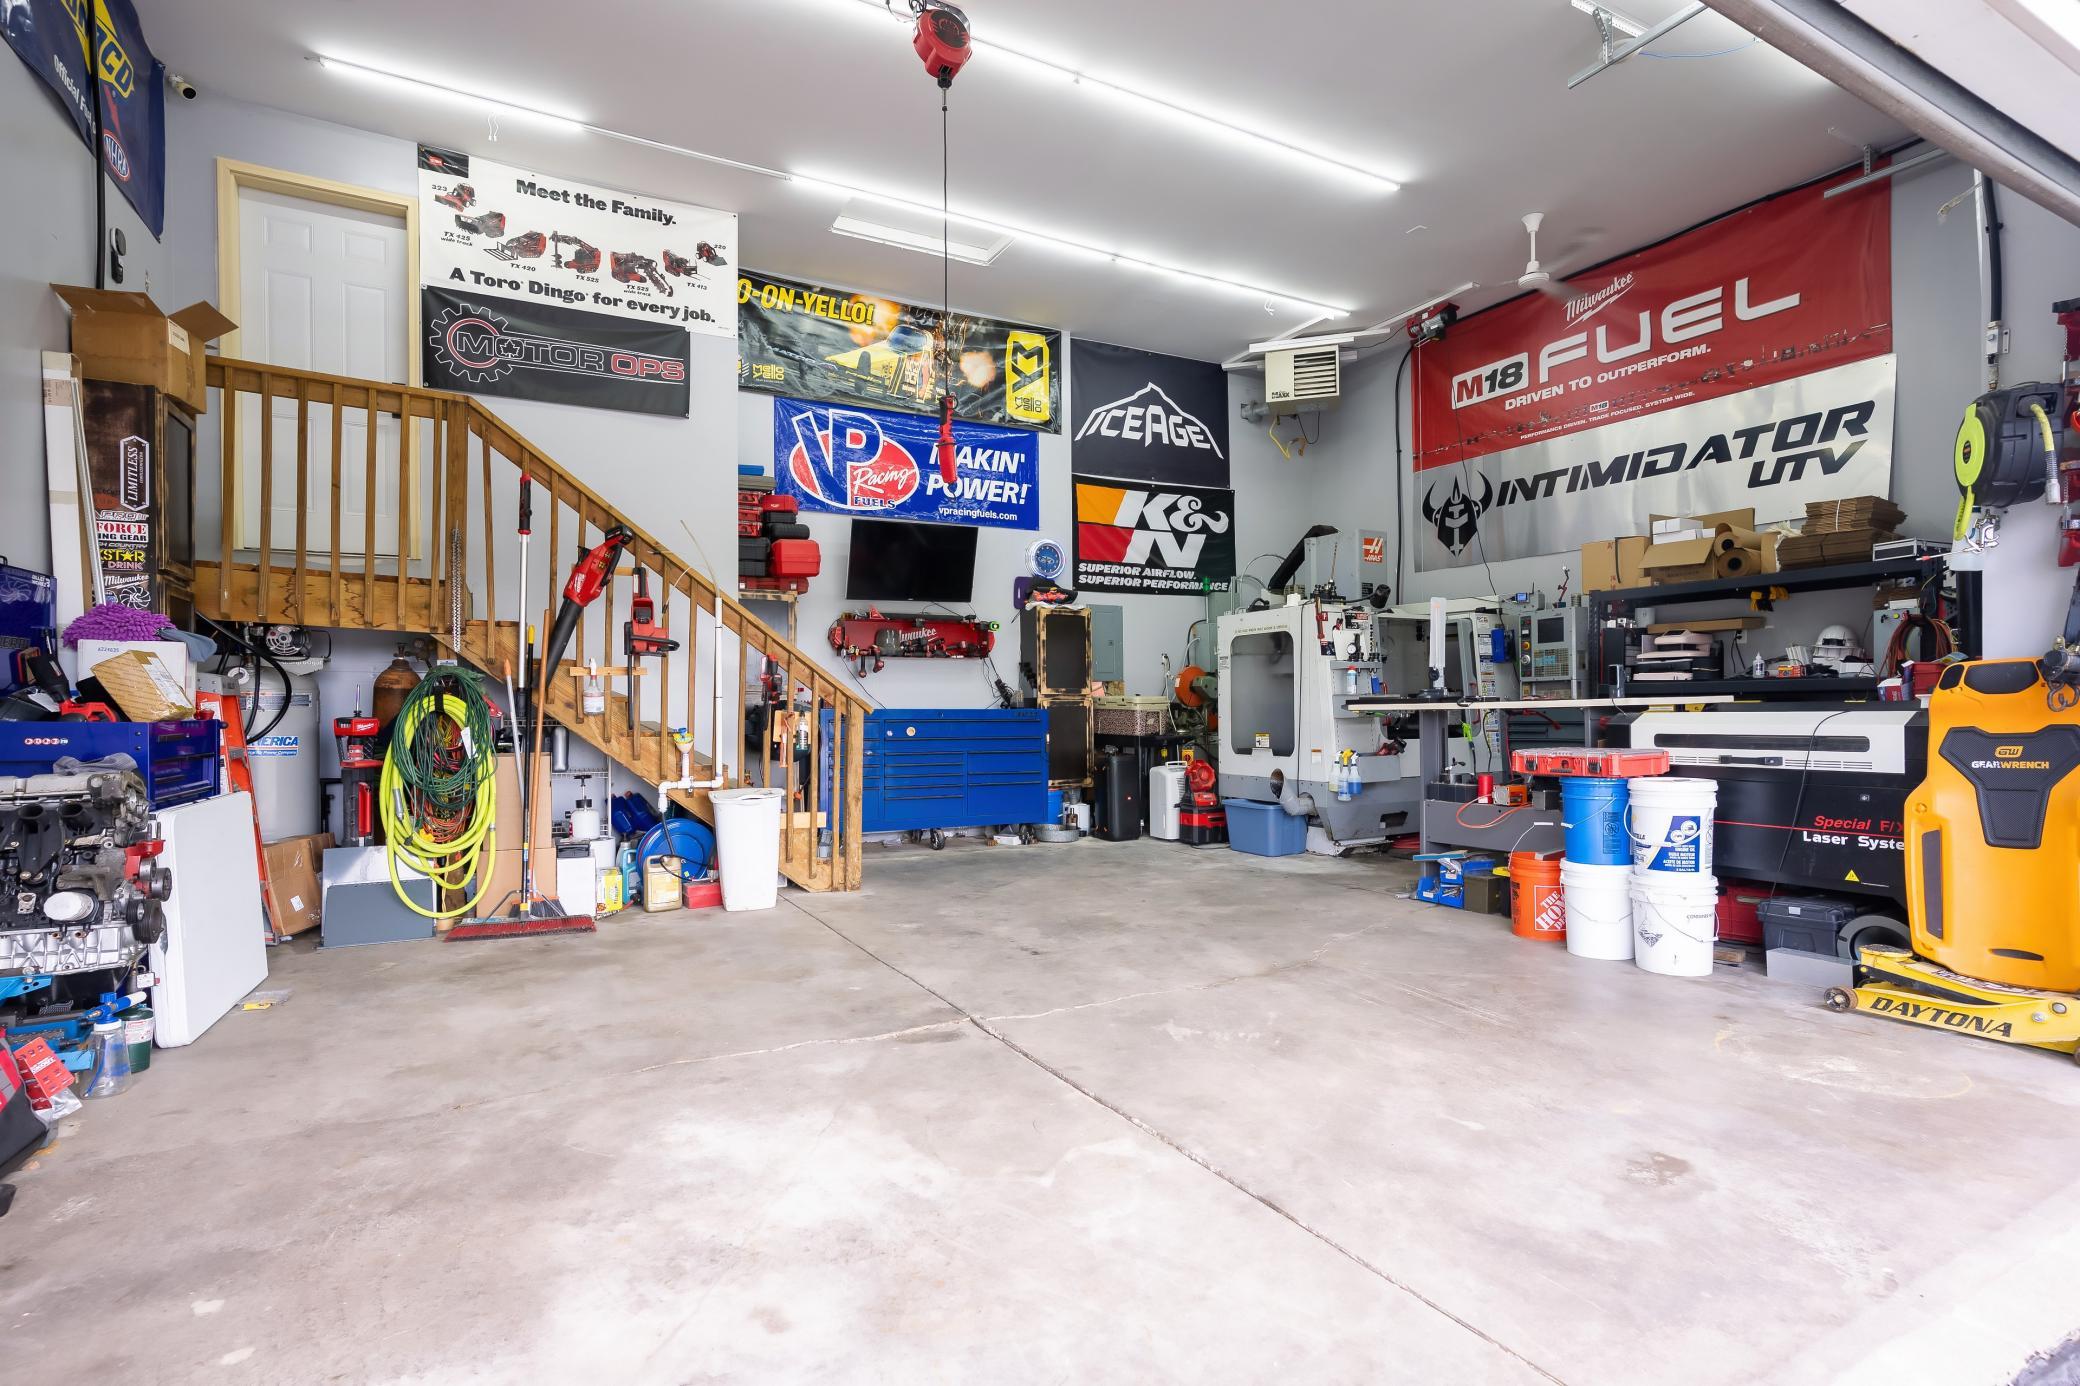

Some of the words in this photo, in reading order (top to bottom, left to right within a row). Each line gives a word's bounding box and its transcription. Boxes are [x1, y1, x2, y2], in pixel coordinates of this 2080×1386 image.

[53, 55, 78, 104] Official
[104, 135, 127, 175] NHRA
[516, 179, 570, 203] Meet
[574, 192, 607, 211] the
[611, 200, 677, 226] Family.
[444, 231, 455, 239] TX
[457, 239, 473, 247] track
[449, 267, 466, 282] A
[470, 270, 521, 291] Toro
[528, 280, 586, 303] Dingo
[592, 292, 623, 307] for
[627, 300, 680, 319] every
[682, 306, 716, 323] job.
[1561, 273, 1634, 322] Milwaukee
[1456, 360, 1525, 402] M18
[1538, 277, 1801, 384] FUEL
[610, 353, 685, 381] OPS
[1505, 383, 1563, 411] DRIVEN
[1568, 373, 1592, 390] TO
[1596, 343, 1712, 384] OUTPERFORM.
[1520, 425, 1562, 440] PERFORMANCE
[1563, 419, 1588, 429] DRIVEN.
[1589, 413, 1609, 422] TRADE
[1610, 405, 1643, 416] FOCUSED.
[1645, 397, 1673, 408] SYSTEM
[1674, 392, 1696, 401] WIDE.
[1589, 400, 1609, 412] M18
[791, 408, 883, 507] VP
[1496, 400, 1875, 507] INTIMIDATOR
[1747, 439, 1868, 489] UTV
[127, 445, 138, 502] LIMITLESS
[853, 466, 916, 494] Racing
[853, 496, 896, 509] FUELS
[926, 474, 1028, 505] POWER!
[938, 507, 1018, 521] vpracingfuels.com
[120, 533, 147, 541] GEAR
[103, 573, 149, 587] Milwaukee
[107, 561, 143, 571] DRINK
[1078, 562, 1142, 576] SUPERIOR
[1142, 566, 1197, 580] AIRFLOW.
[1078, 574, 1142, 587] SUPERIOR
[1971, 760, 2050, 769] GEARWRENCH
[1814, 814, 1872, 832] Special
[1802, 830, 1848, 846] Laser
[1541, 890, 1561, 910] THE
[1536, 900, 1566, 930] HO
[1869, 997, 2013, 1038] DAYTONA
